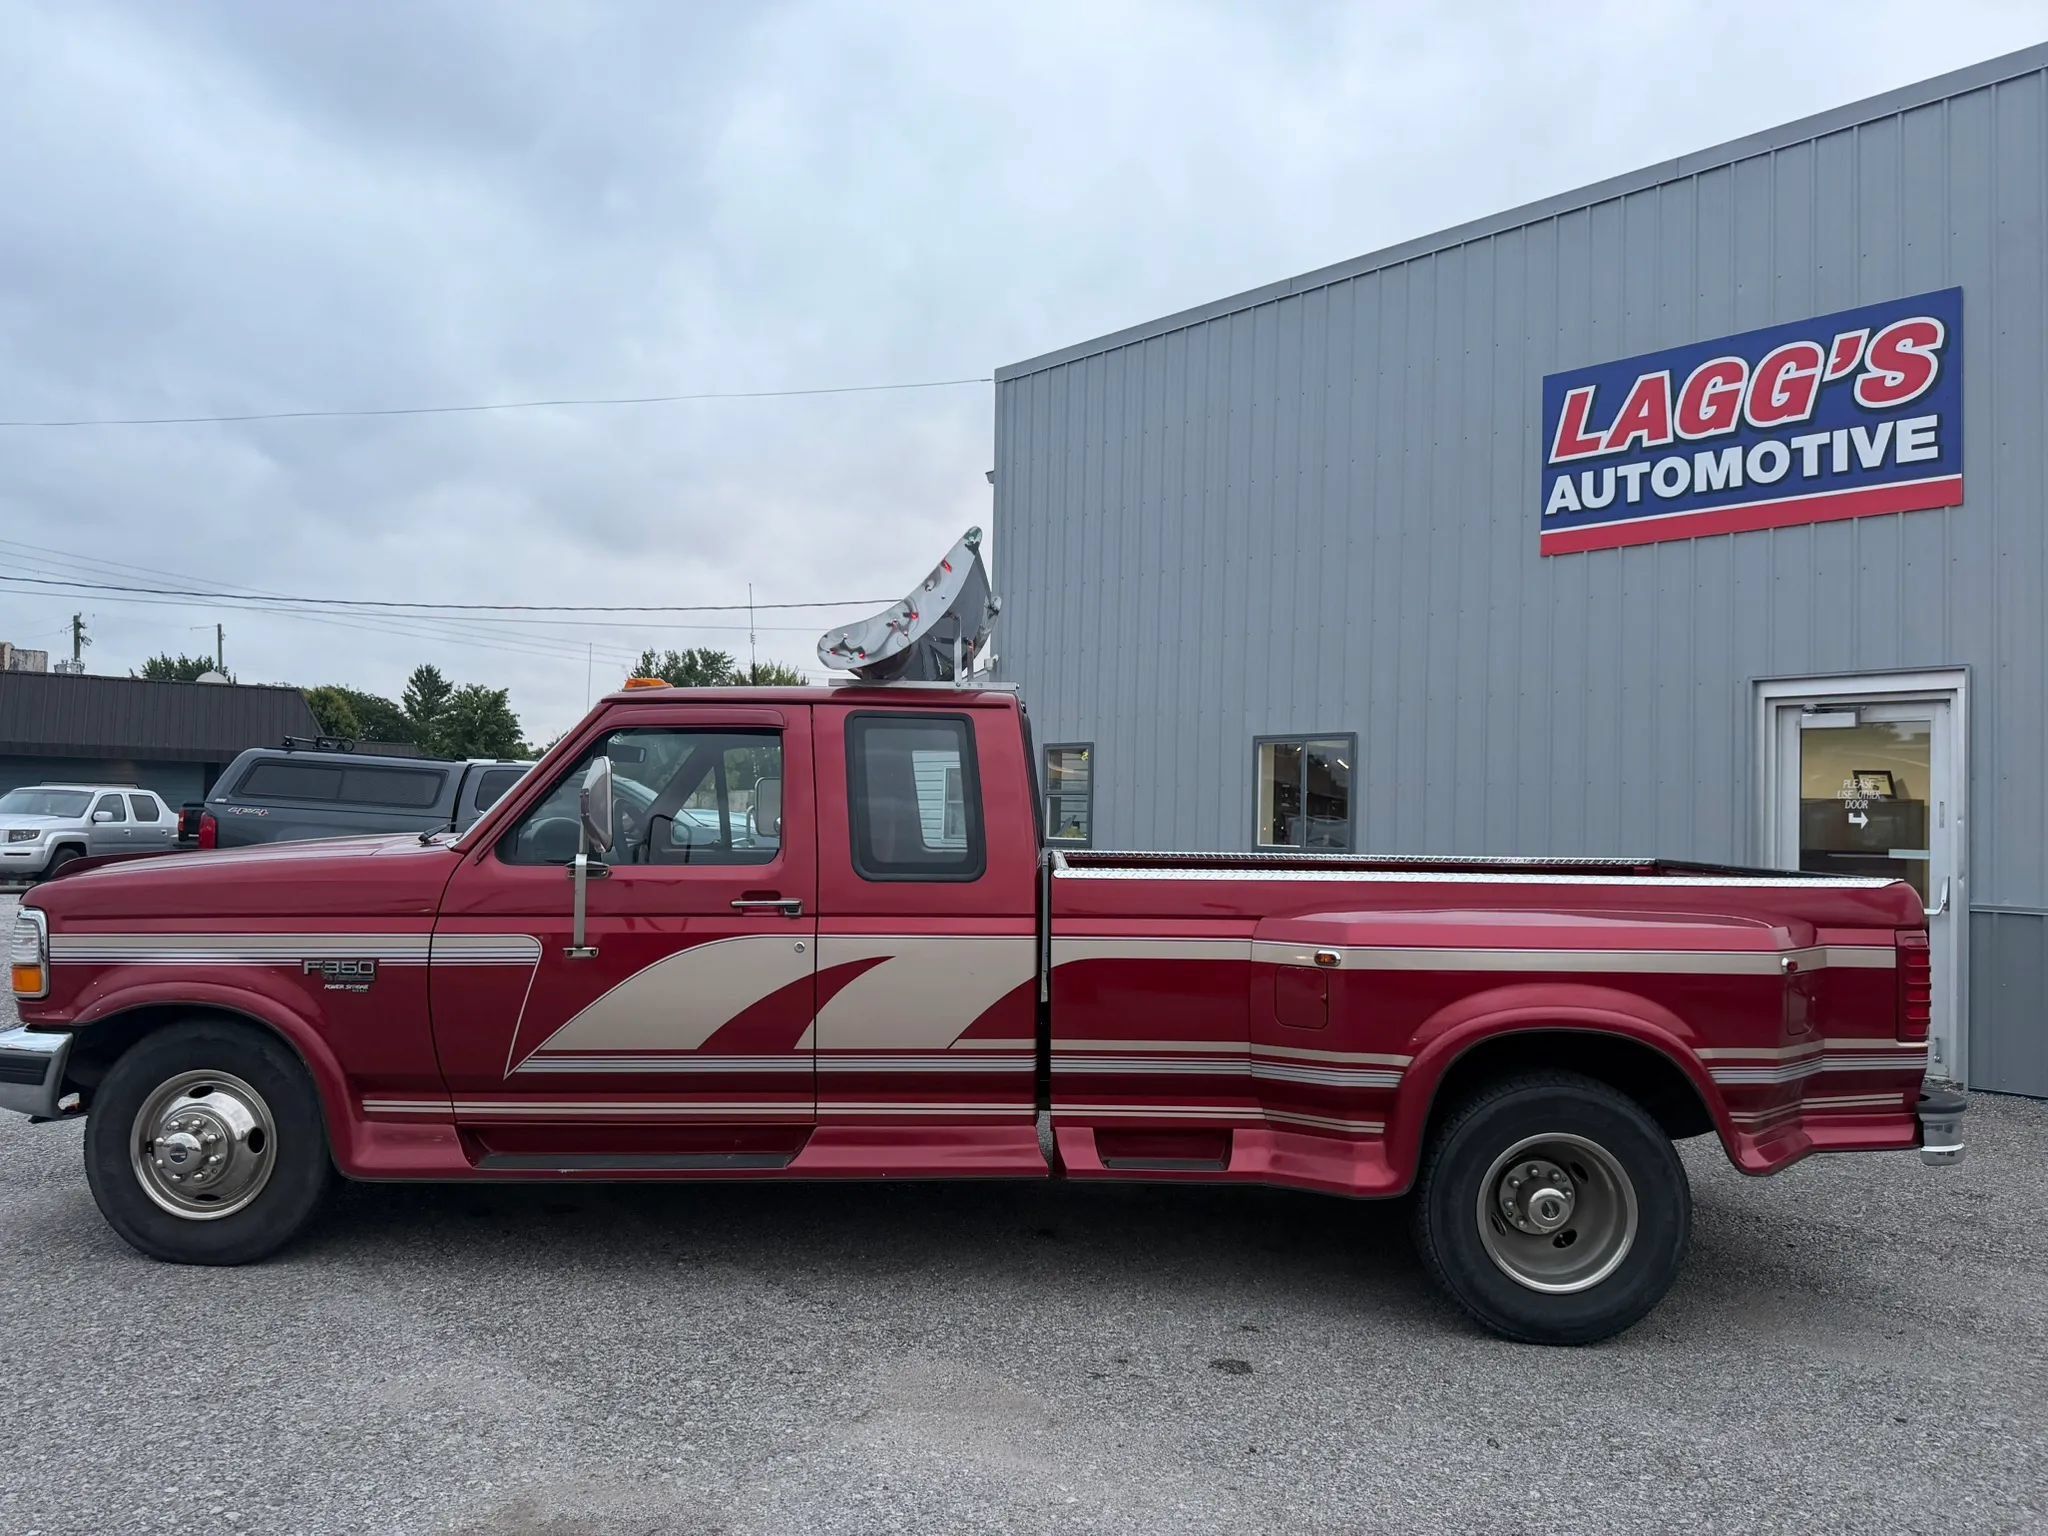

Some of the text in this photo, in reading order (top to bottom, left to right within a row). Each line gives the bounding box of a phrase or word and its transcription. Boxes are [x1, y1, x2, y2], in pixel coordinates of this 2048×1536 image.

[1548, 316, 1945, 464] LAGG'S
[1545, 414, 1938, 515] AUTOMOTIVE
[1843, 779, 1874, 789] PLEASE
[1837, 790, 1880, 800] USE OTHER
[1844, 799, 1869, 810] DOOR
